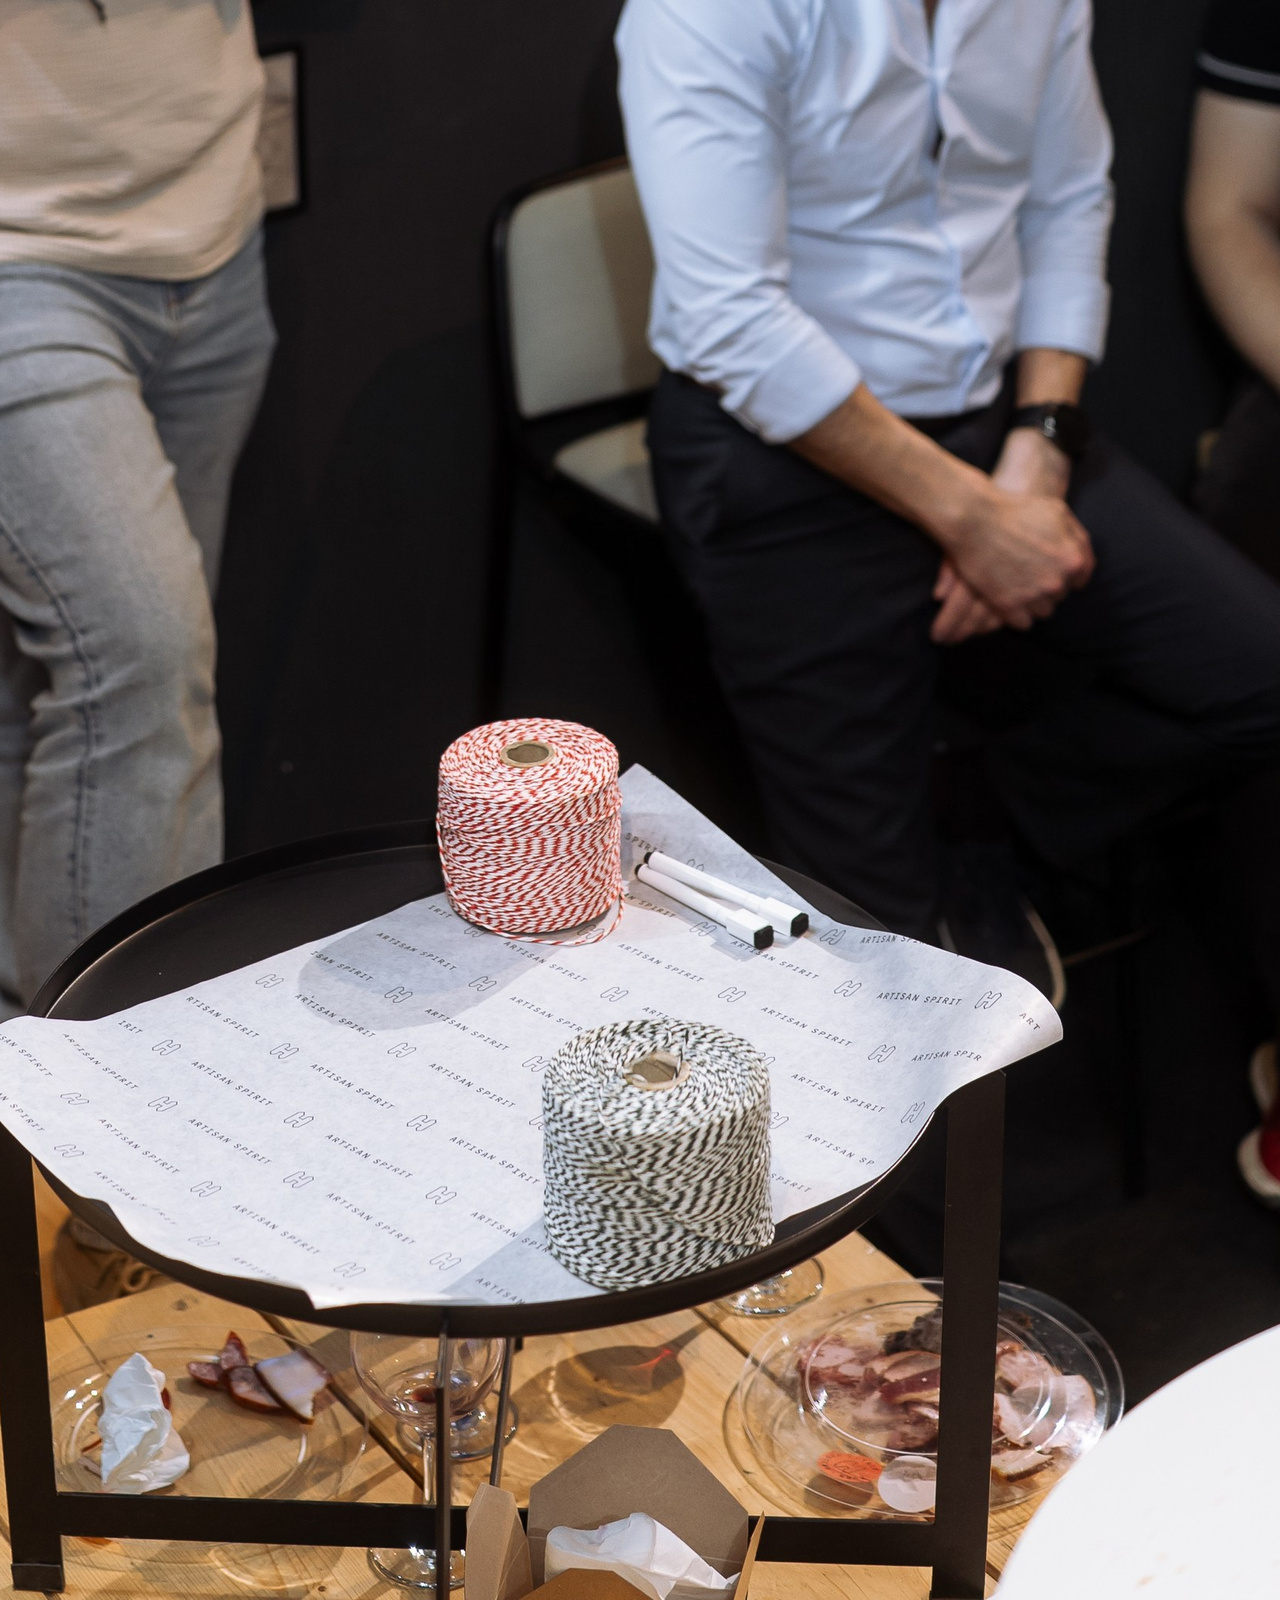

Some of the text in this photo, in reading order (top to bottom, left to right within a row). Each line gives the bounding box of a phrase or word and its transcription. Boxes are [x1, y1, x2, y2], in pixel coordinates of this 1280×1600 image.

[428, 905, 452, 919] IRIT
[638, 900, 676, 918] SPIRIT
[376, 932, 457, 971] ARTISAN SPIRIT
[860, 935, 897, 944] ARTISAN
[311, 951, 373, 981] ISAN SPIRIT
[503, 941, 588, 983] ARTISAN SPIRIT
[618, 943, 704, 983] ARTISAN SPIRIT
[779, 961, 820, 981] SPIRIT
[186, 996, 260, 1038] RTISAN SPIRIT
[295, 994, 376, 1038] ARTISAN SPIRIT
[509, 996, 583, 1032] ARTISAN SPIR
[877, 993, 962, 1006] ARTISAN SPIRIT
[118, 1020, 143, 1034] IRIT
[425, 1008, 510, 1051] ARTISAN SPIRIT
[761, 1007, 853, 1046] ARTISAN SPIRIT
[1020, 1013, 1040, 1030] ART
[19, 1049, 53, 1077] SPIRIT
[62, 1033, 139, 1089] ARTISAN SPIRIT
[912, 1050, 982, 1062] ARTISAN SPIR
[191, 1061, 273, 1105] ARTISAN SPIRIT
[310, 1064, 395, 1109] ARTISAN SPIRIT
[428, 1063, 516, 1108] ARTISAN SPIRIT
[790, 1074, 885, 1114] ARTISAN SPIRIT
[10, 1104, 45, 1132] SPIRIT
[98, 1119, 180, 1174] ARTISAN SPIRIT
[188, 1119, 272, 1164] ARTISAN SPIRIT
[325, 1134, 414, 1178] ARTISAN SPIRIT
[449, 1137, 540, 1185] ARTISAN SPIRIT
[805, 1134, 874, 1166] ARTISAN SP
[770, 1173, 812, 1192] SPIRIT
[232, 1205, 321, 1255] ARTISAN SPIRIT
[326, 1193, 416, 1245] ARTISAN SPIRIT
[470, 1212, 519, 1238] ARTISAN
